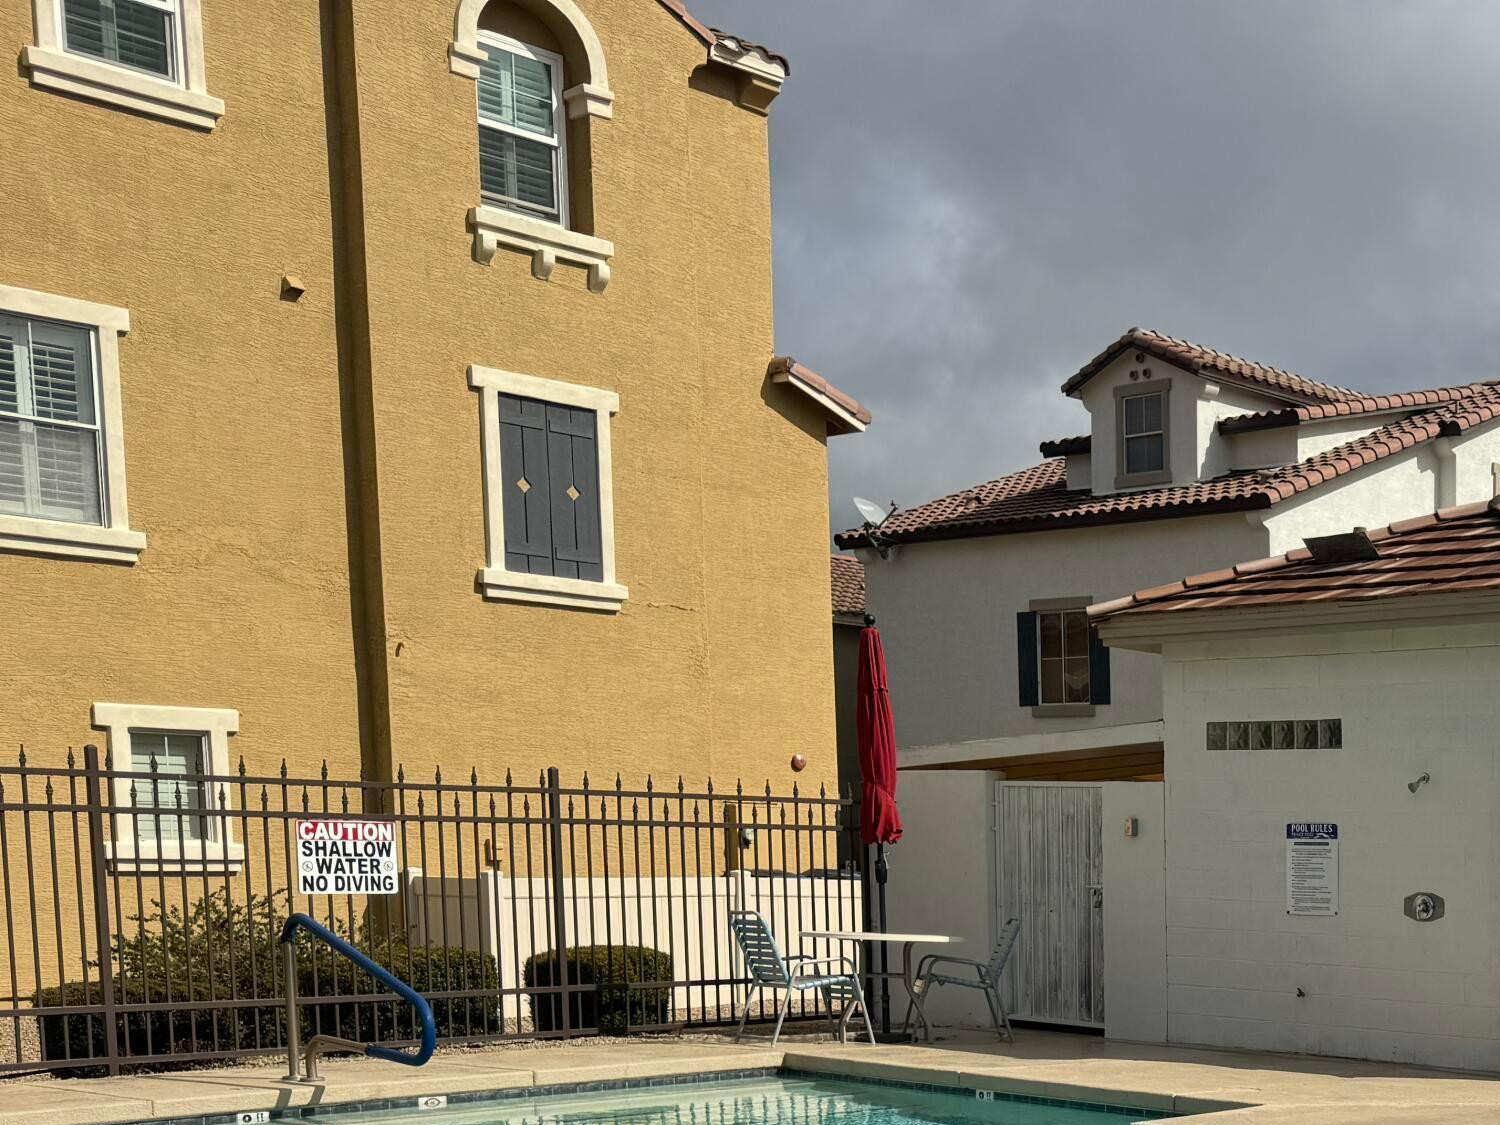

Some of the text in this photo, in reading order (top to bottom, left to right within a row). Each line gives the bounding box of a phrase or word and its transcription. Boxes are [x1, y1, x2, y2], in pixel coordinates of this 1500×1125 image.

[299, 822, 392, 841] CAUTION
[1291, 824, 1333, 833] POOL RULES
[302, 840, 392, 857] SHALLOW
[316, 858, 381, 874] WATER
[302, 875, 394, 892] NO DIVING
